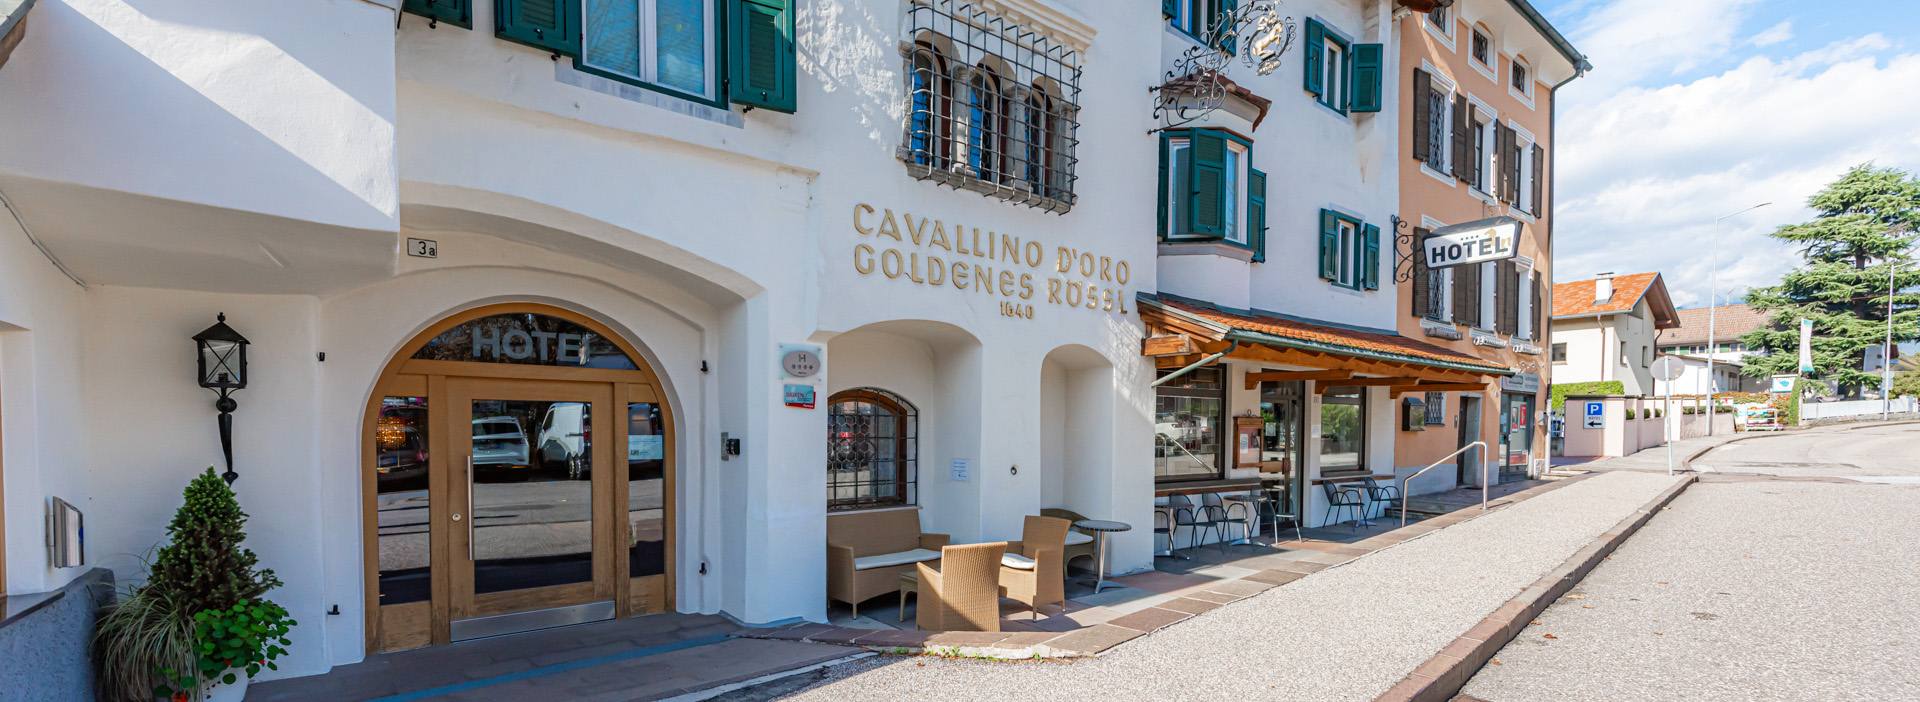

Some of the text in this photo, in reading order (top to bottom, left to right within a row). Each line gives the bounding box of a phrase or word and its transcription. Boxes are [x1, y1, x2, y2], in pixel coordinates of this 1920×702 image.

[418, 240, 436, 256] 3a
[853, 203, 1131, 286] CAVALLINO D'ORO
[1431, 236, 1509, 264] HOTEL
[854, 243, 1035, 300] GOLDENES
[1000, 300, 1034, 320] 1640
[1590, 404, 1600, 415] P
